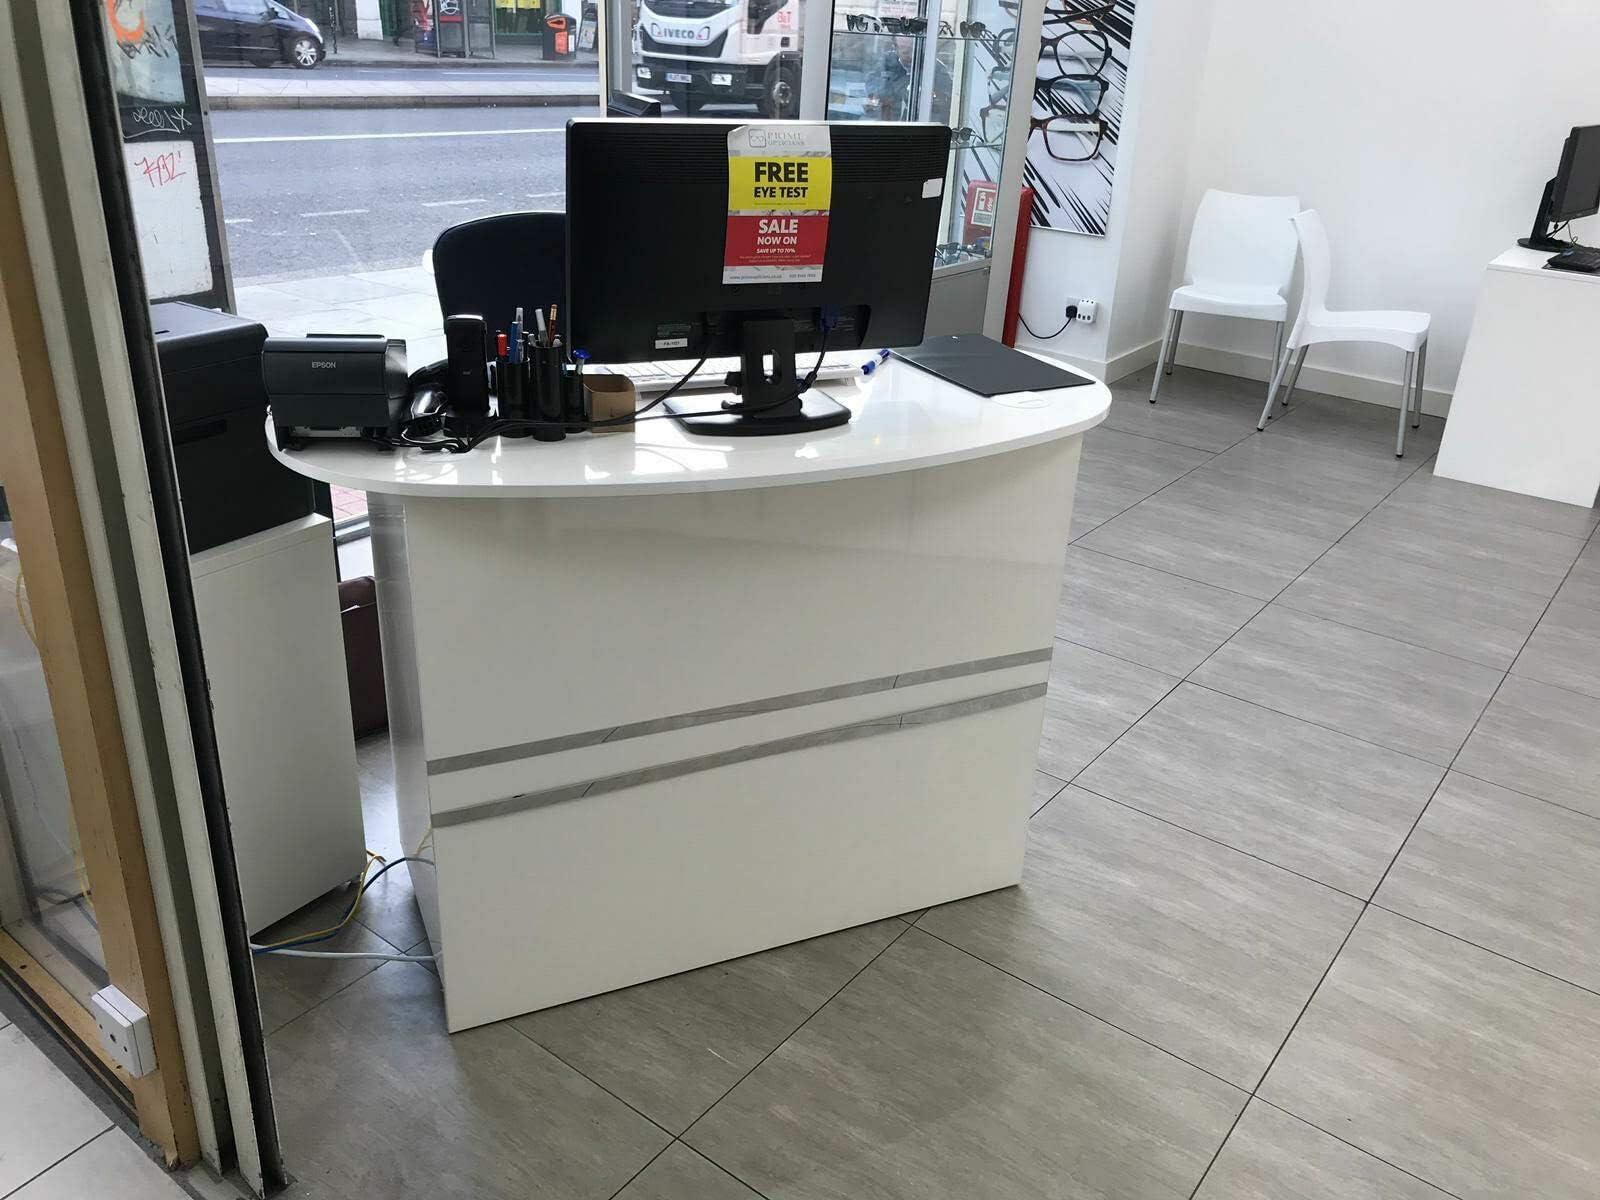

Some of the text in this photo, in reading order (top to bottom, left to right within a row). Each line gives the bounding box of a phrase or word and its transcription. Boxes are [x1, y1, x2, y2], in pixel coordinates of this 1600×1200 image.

[664, 28, 695, 39] IVECO
[767, 131, 802, 140] PRIME
[754, 162, 808, 183] FREE
[754, 187, 808, 198] EYE TEST
[758, 219, 799, 234] SALE
[757, 236, 797, 245] NOW ON
[311, 361, 337, 369] EPSON
